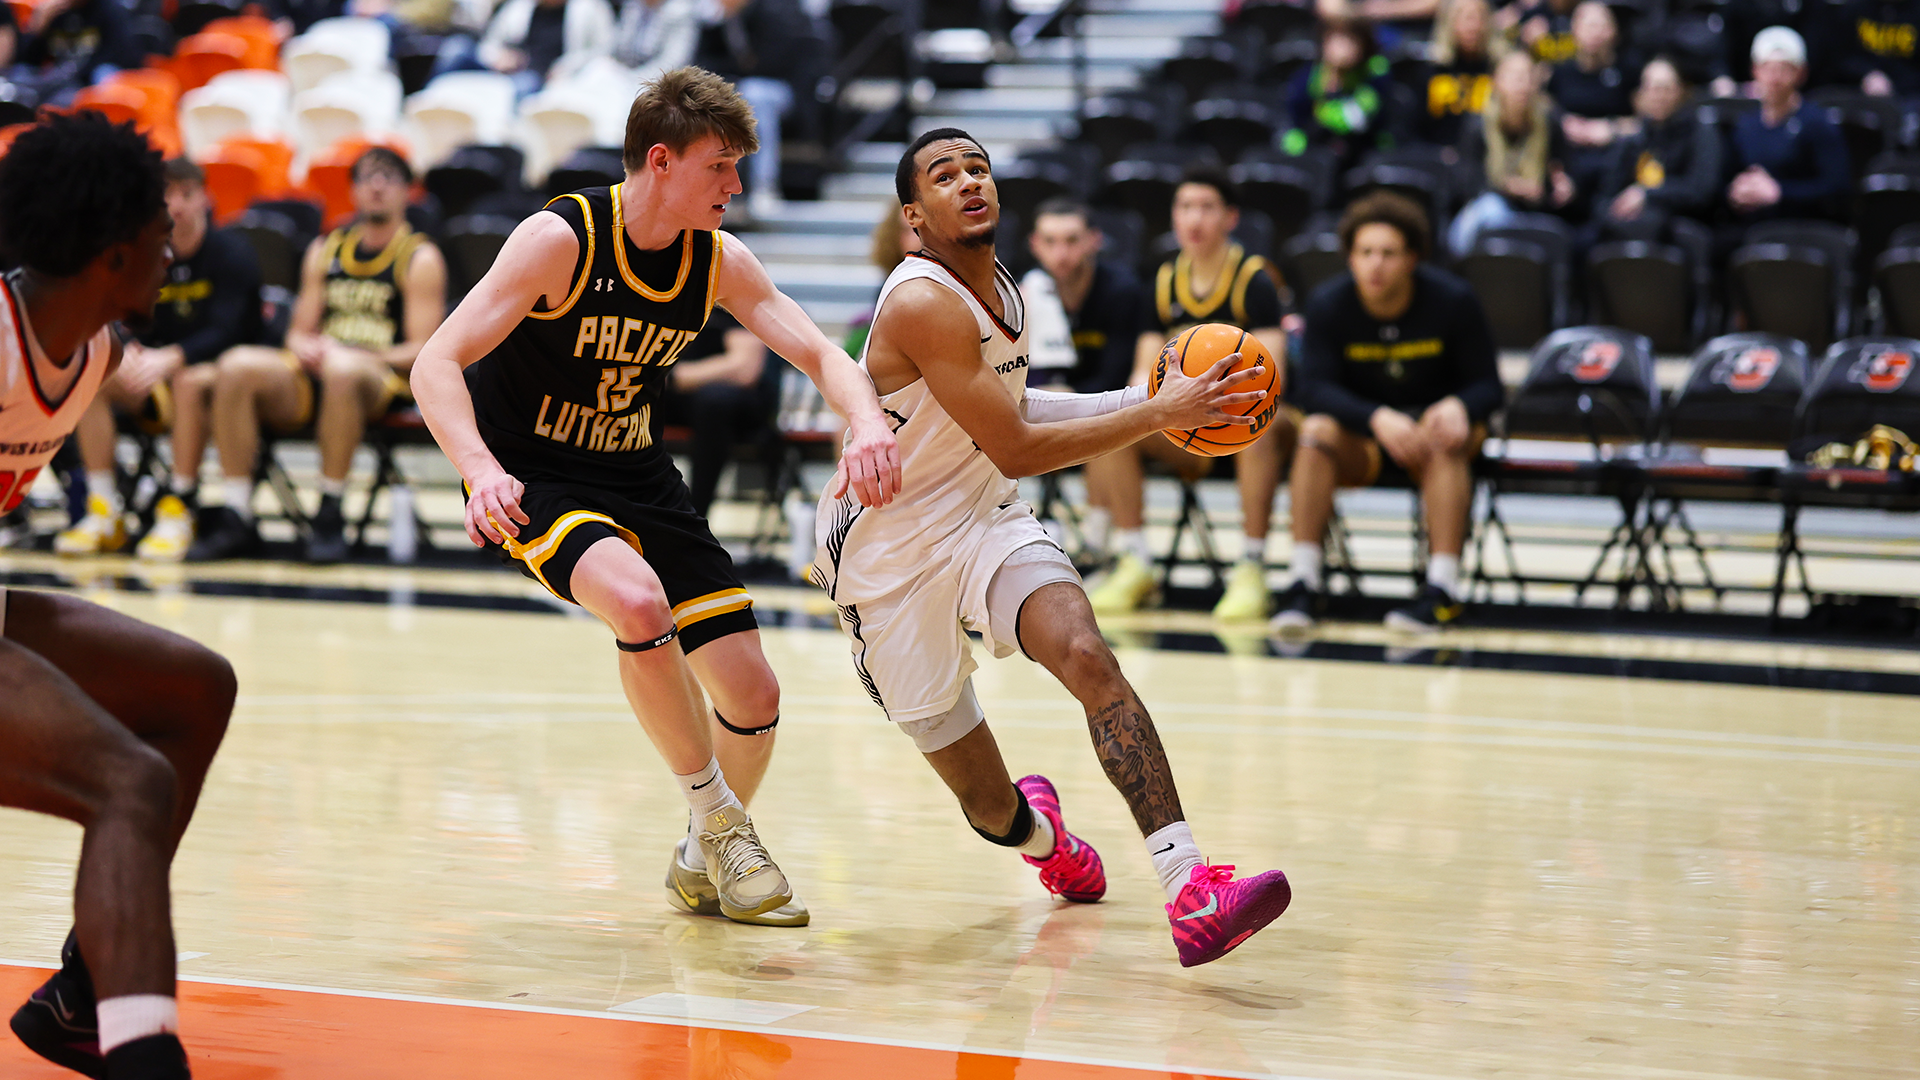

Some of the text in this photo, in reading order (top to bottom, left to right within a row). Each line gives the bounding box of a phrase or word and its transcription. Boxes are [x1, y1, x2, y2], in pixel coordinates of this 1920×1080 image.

[573, 315, 699, 367] PACIFIC
[596, 366, 643, 412] 15
[534, 394, 653, 453] LUTHERAN
